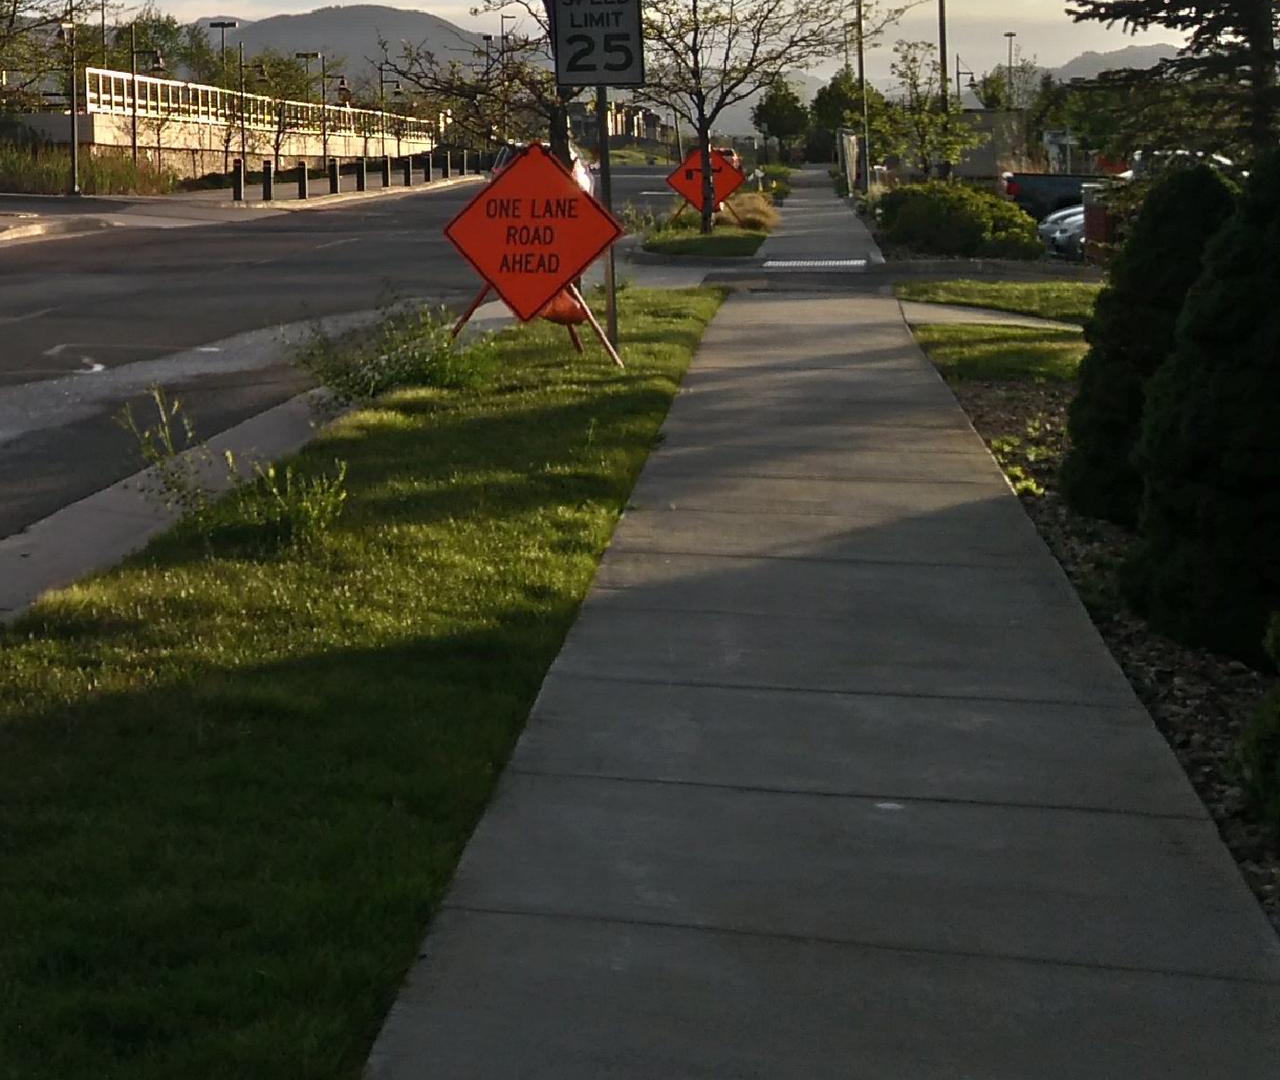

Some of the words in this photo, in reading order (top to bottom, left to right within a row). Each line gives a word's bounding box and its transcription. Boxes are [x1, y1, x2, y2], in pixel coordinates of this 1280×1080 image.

[570, 11, 624, 28] LIMIT
[566, 33, 634, 72] 25
[486, 198, 522, 218] ONE
[531, 198, 579, 218] LANE
[506, 225, 554, 245] ROAD
[499, 253, 560, 273] AHEAD
